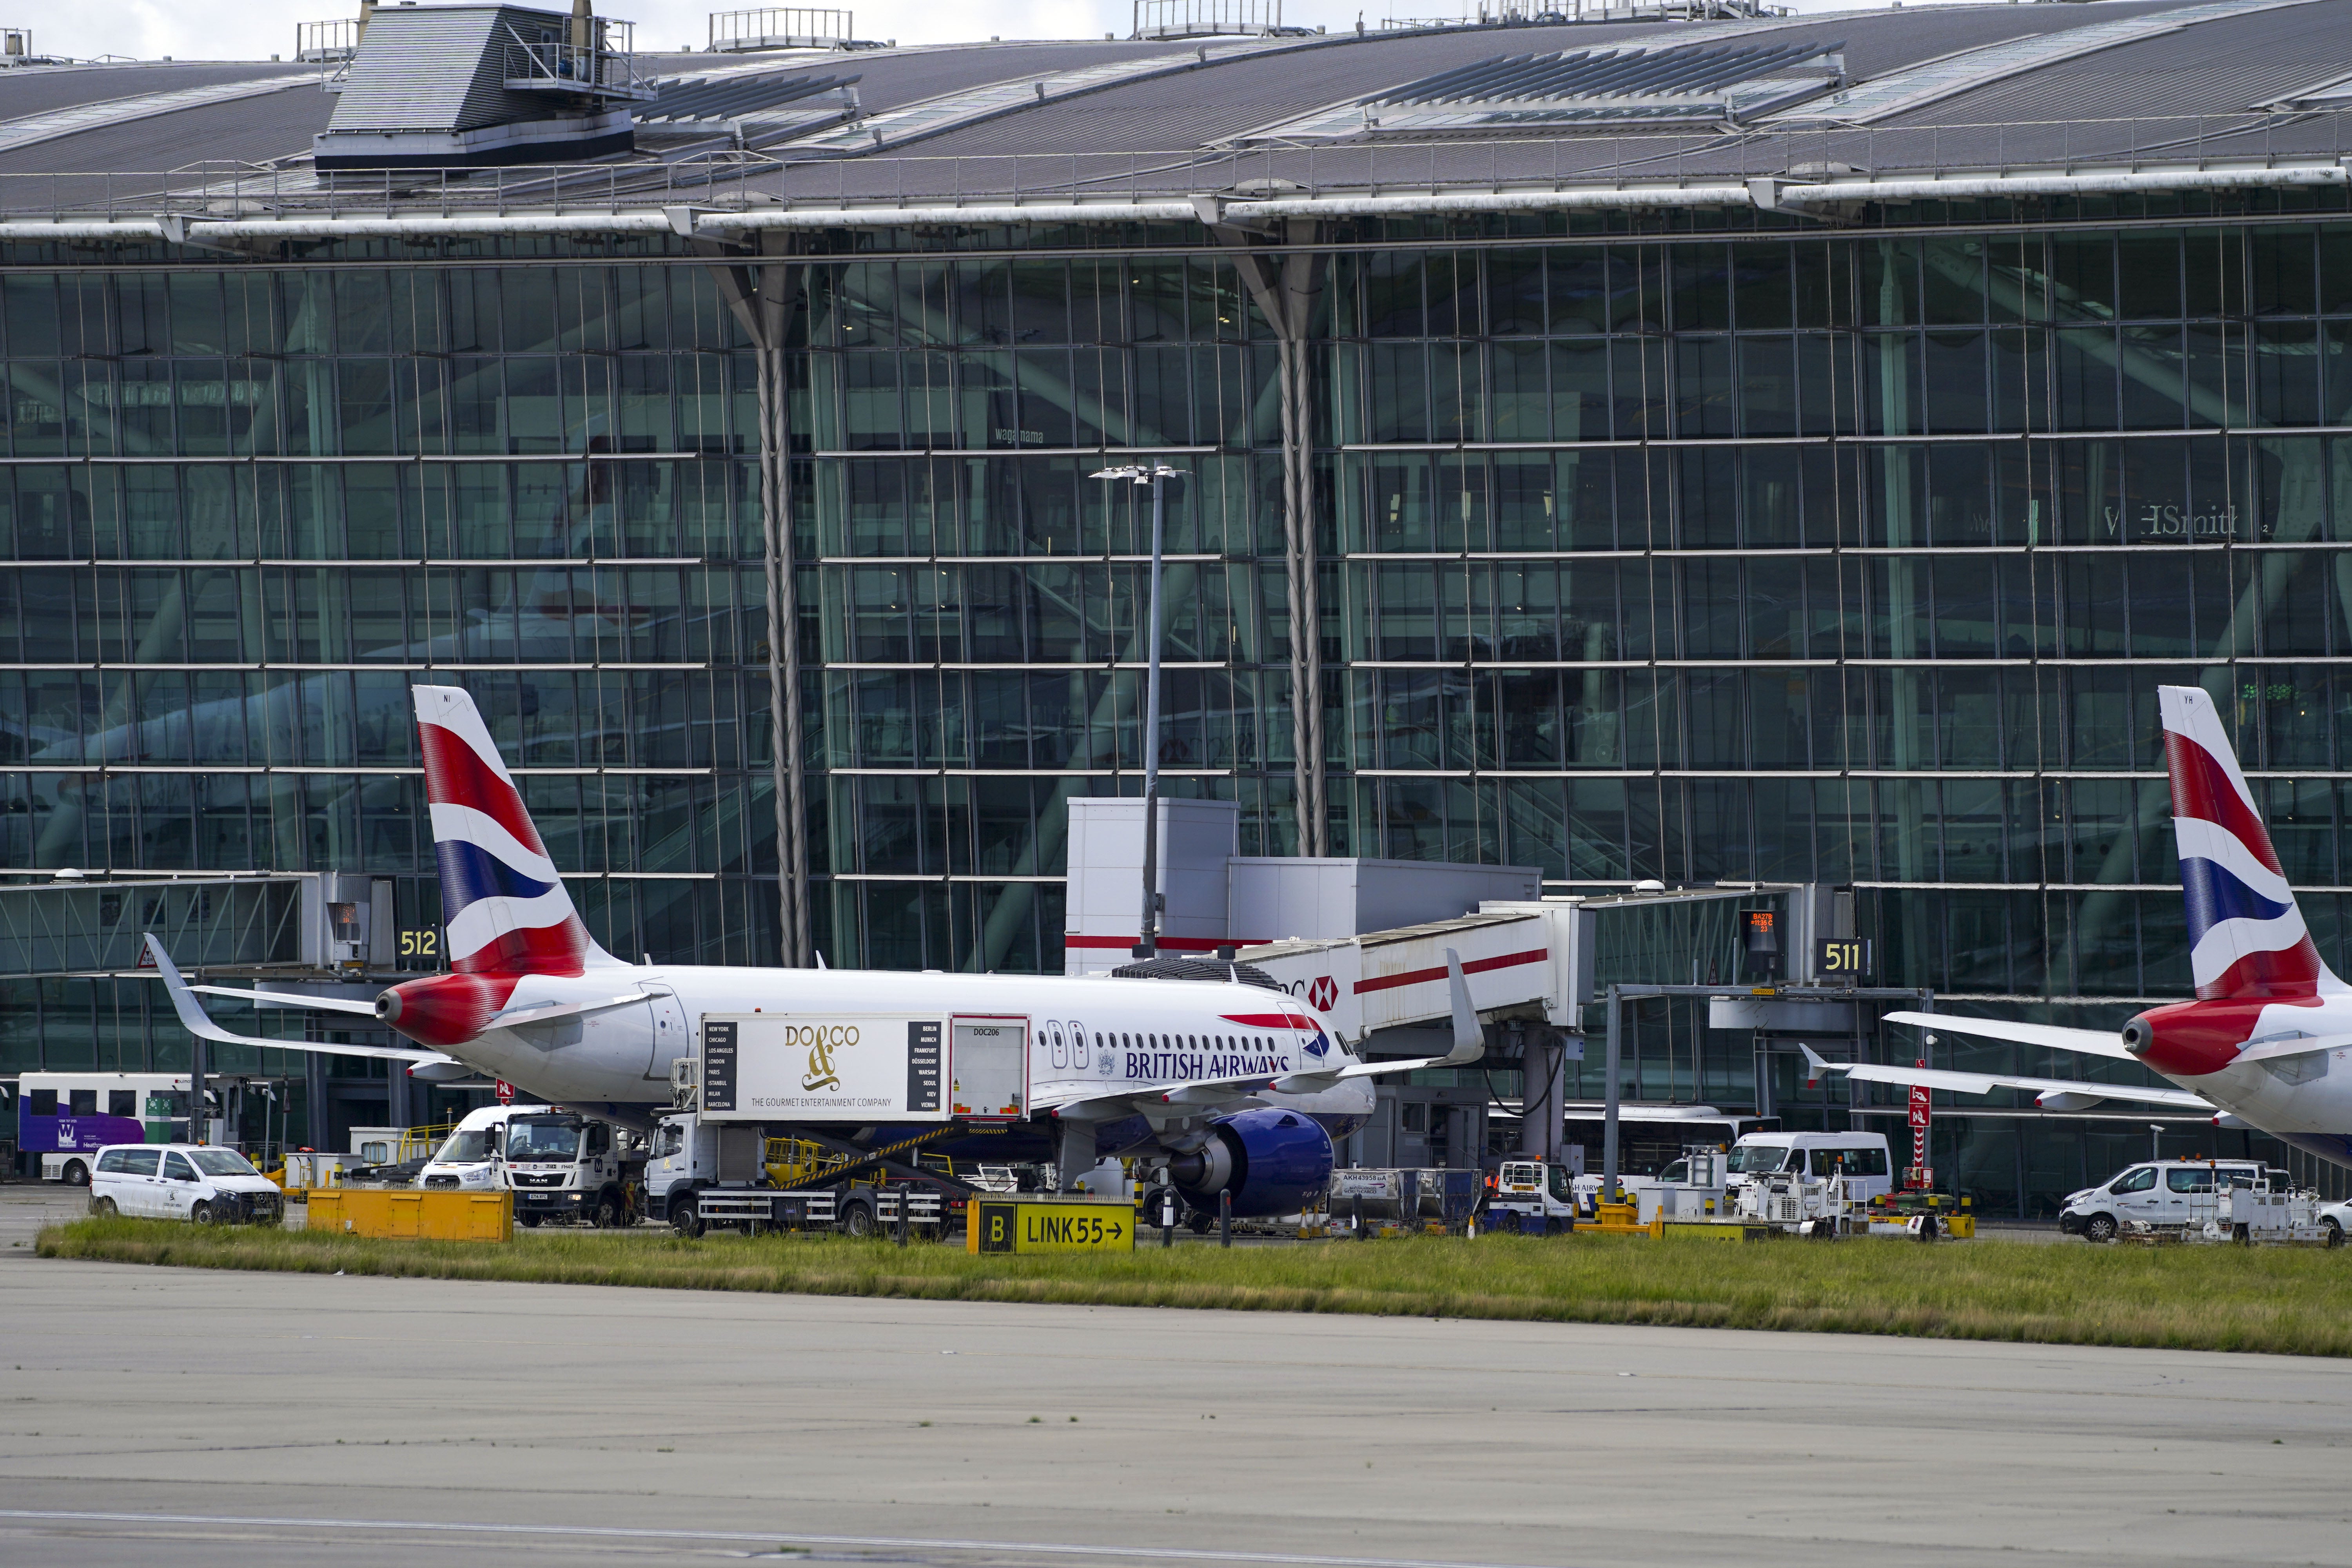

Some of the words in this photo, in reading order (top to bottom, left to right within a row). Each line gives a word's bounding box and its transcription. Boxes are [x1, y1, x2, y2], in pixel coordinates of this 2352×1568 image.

[401, 931, 436, 955] 512
[1826, 944, 1859, 970] 511
[1125, 1053, 1203, 1079] BRITISH
[1207, 1054, 1290, 1079] AIRWAYS
[751, 1098, 764, 1106] THE
[766, 1098, 799, 1107] GOURMET
[801, 1098, 855, 1107] ENTERTAINMENT
[857, 1098, 891, 1107] COMPANY
[992, 1216, 1004, 1242] B
